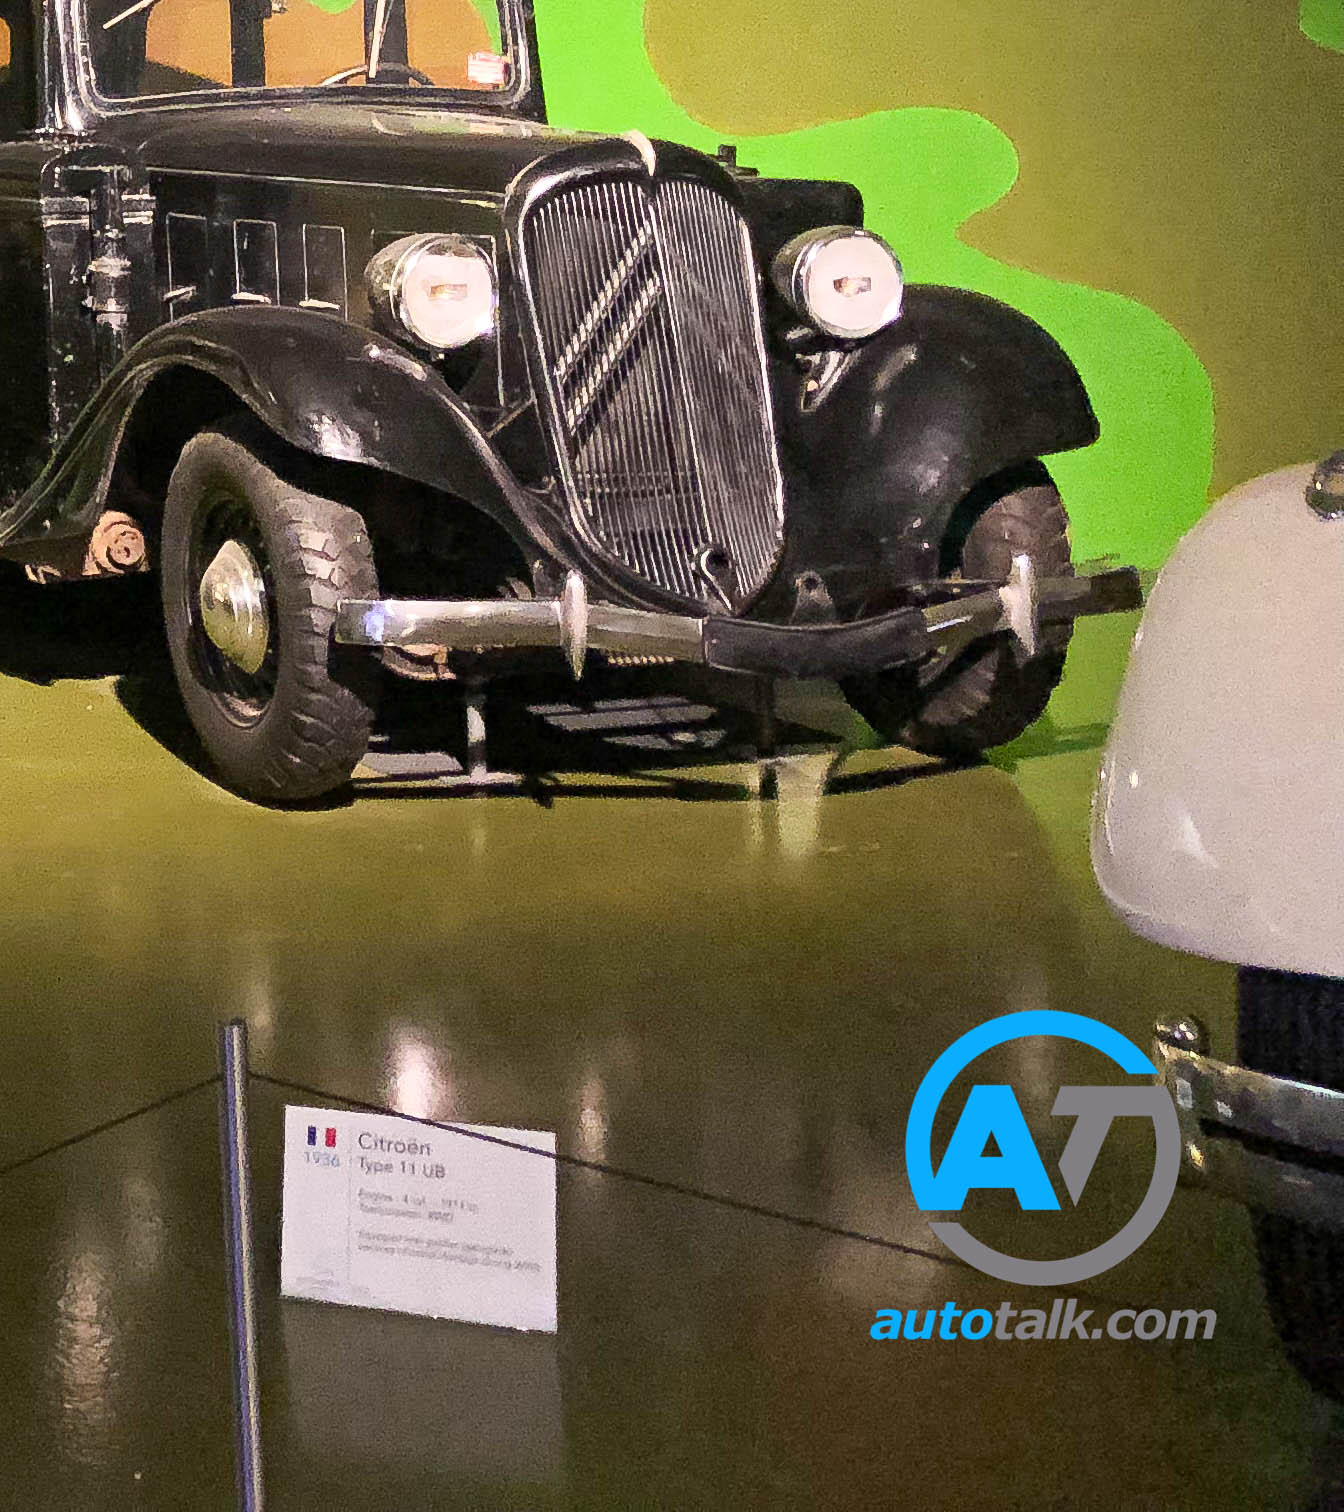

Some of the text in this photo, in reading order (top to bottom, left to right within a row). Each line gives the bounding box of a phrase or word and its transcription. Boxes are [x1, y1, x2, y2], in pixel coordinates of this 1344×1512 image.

[358, 1132, 432, 1157] Citroën
[359, 1156, 446, 1179] Type 11 UB
